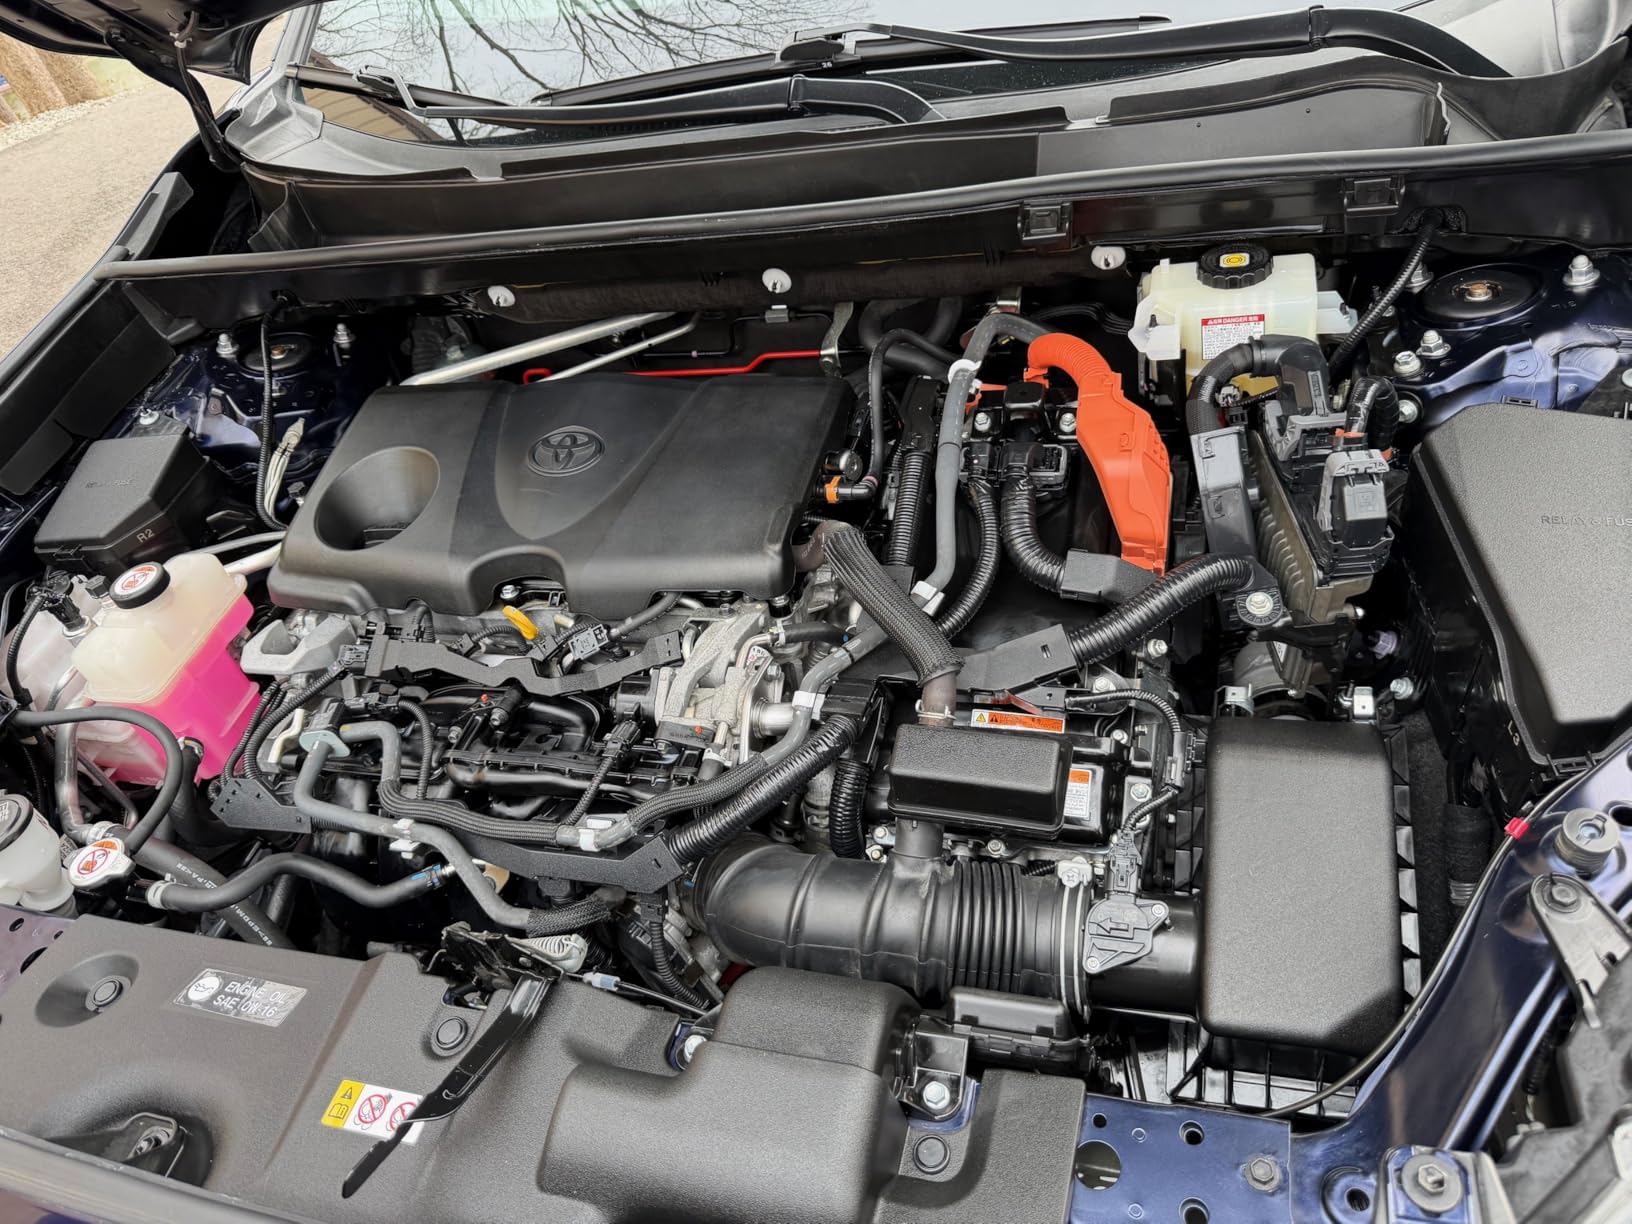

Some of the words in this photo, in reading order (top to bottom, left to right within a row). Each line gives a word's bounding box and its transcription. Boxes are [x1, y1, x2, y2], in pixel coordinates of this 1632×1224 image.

[136, 528, 156, 544] R2
[224, 980, 268, 999] ENGINE
[269, 990, 287, 1005] OIL
[212, 994, 240, 1010] SAE
[240, 1000, 278, 1018] 0W-16
